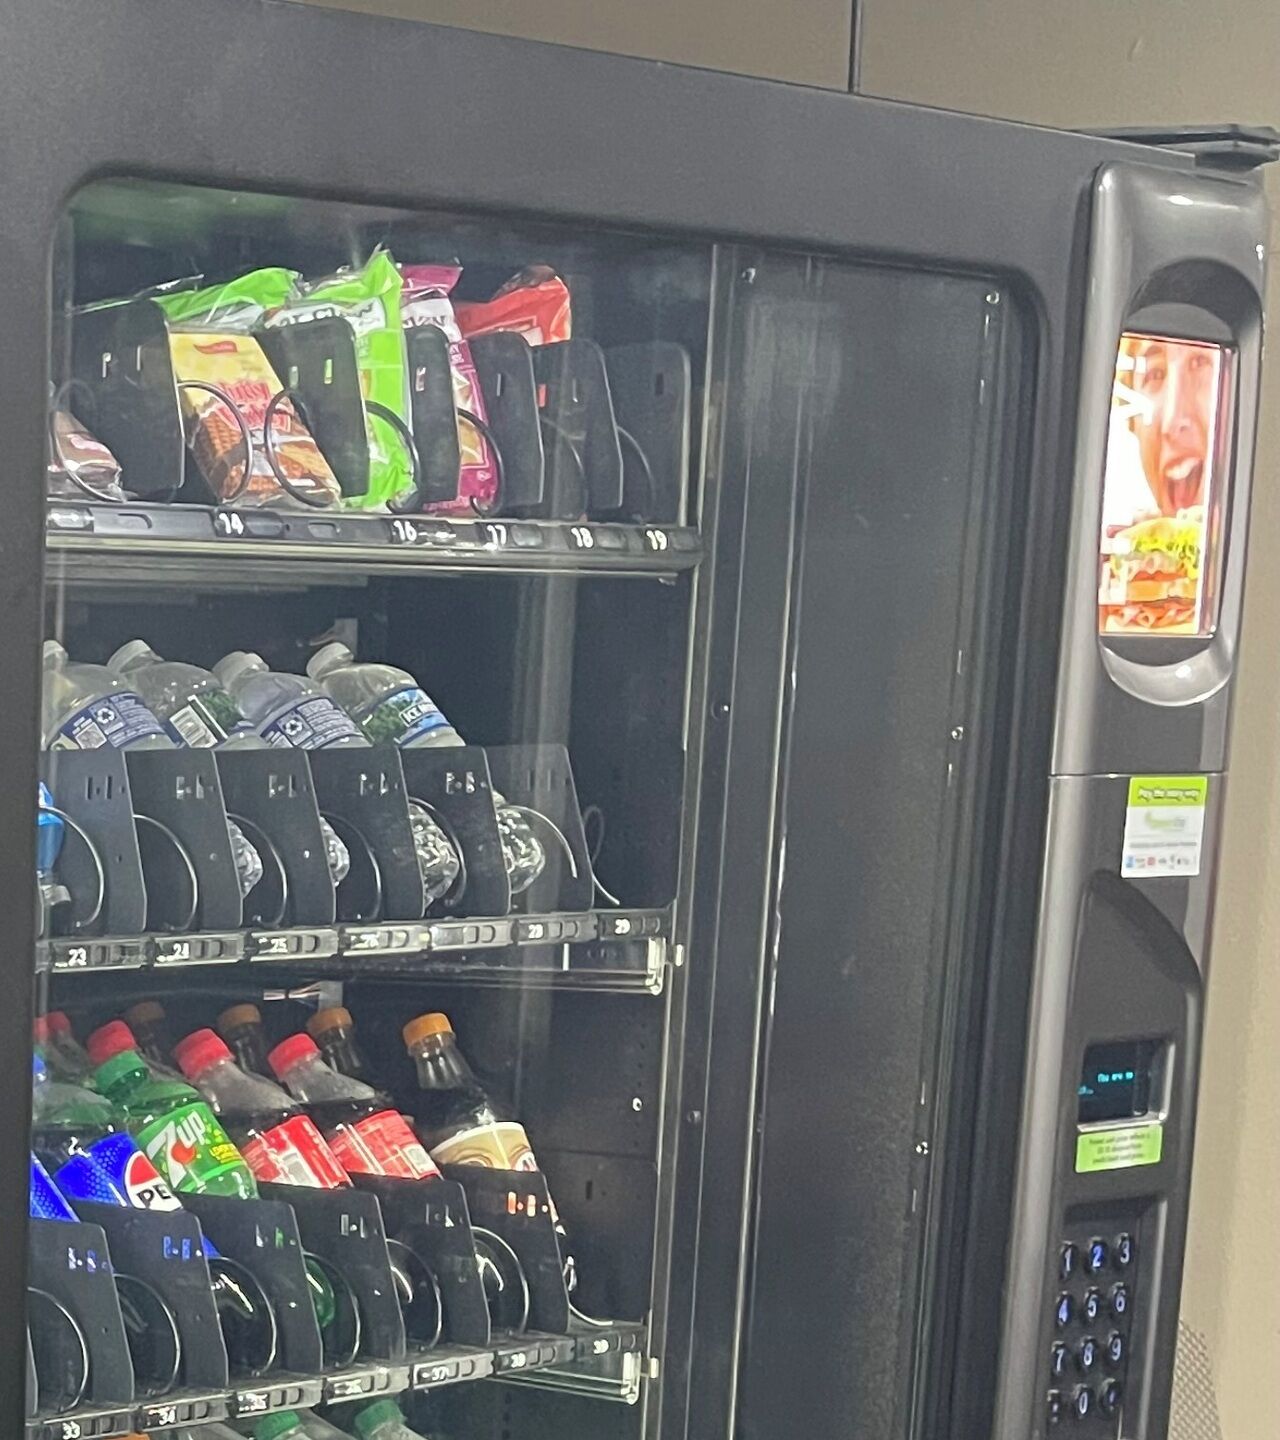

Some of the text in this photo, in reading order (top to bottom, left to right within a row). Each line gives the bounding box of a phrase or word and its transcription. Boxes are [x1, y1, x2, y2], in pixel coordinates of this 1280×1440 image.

[394, 520, 416, 541] 16
[573, 528, 594, 549] 18
[647, 530, 668, 551] 19
[1064, 1240, 1131, 1272] 1 2 3
[1058, 1288, 1127, 1323] 4 5 6
[1054, 1337, 1122, 1372] 7 8 9
[1078, 1391, 1089, 1415] 0
